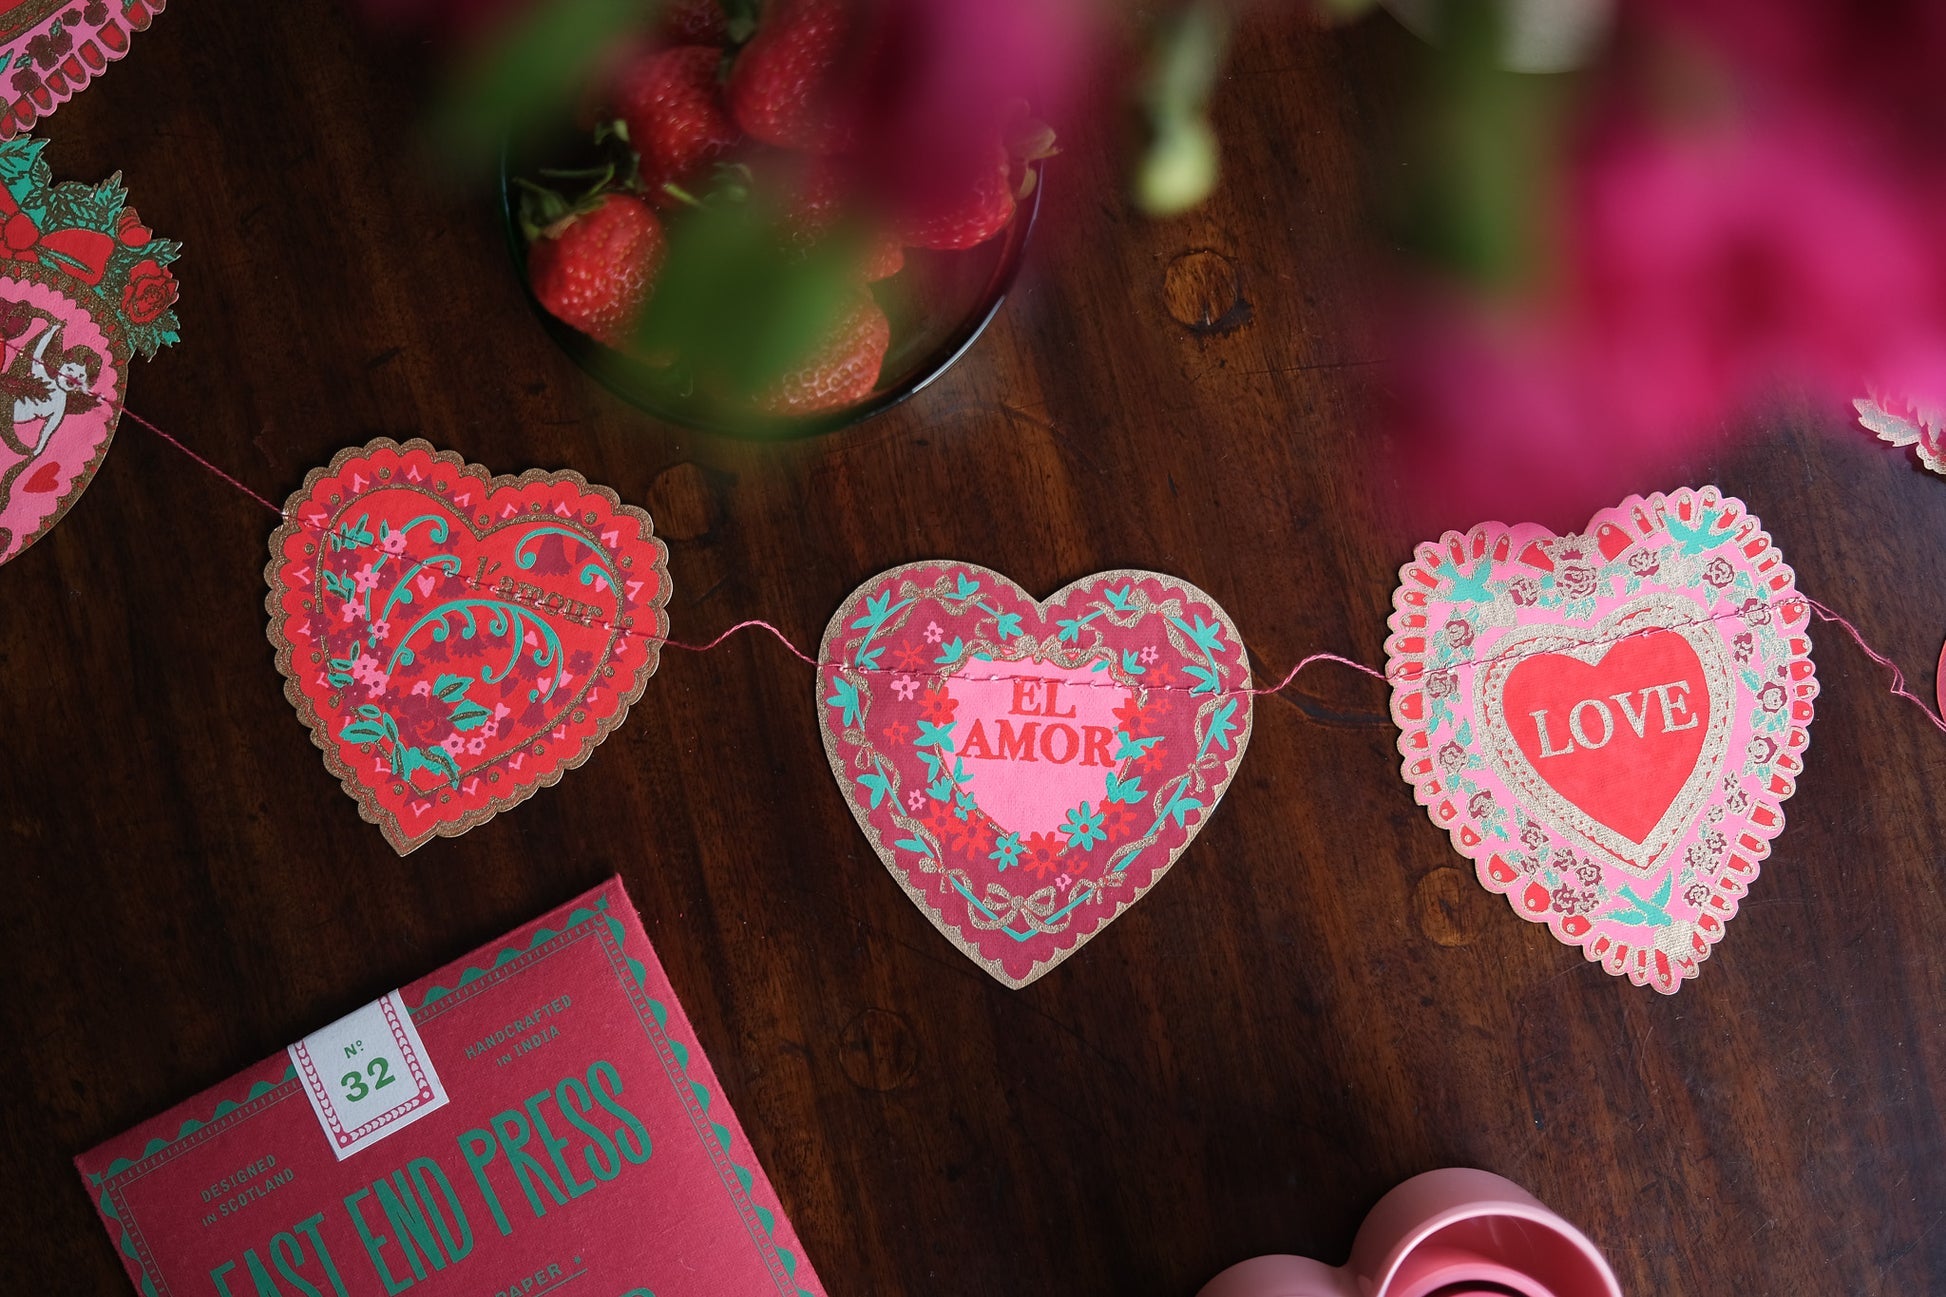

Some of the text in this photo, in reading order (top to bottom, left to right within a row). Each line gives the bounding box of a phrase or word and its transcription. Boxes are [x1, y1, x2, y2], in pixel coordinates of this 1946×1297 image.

[1008, 675, 1076, 718] EL
[1529, 680, 1698, 759] LOVE
[956, 718, 1116, 768] AMOR
[464, 994, 572, 1060] HANDCRAFTED
[513, 1025, 561, 1057] INDIA
[341, 1056, 396, 1102] 32
[201, 1154, 276, 1203] DESIGNED
[218, 1168, 294, 1217] SCOTLAND
[343, 1156, 474, 1297] END
[456, 1060, 653, 1237] PRESS
